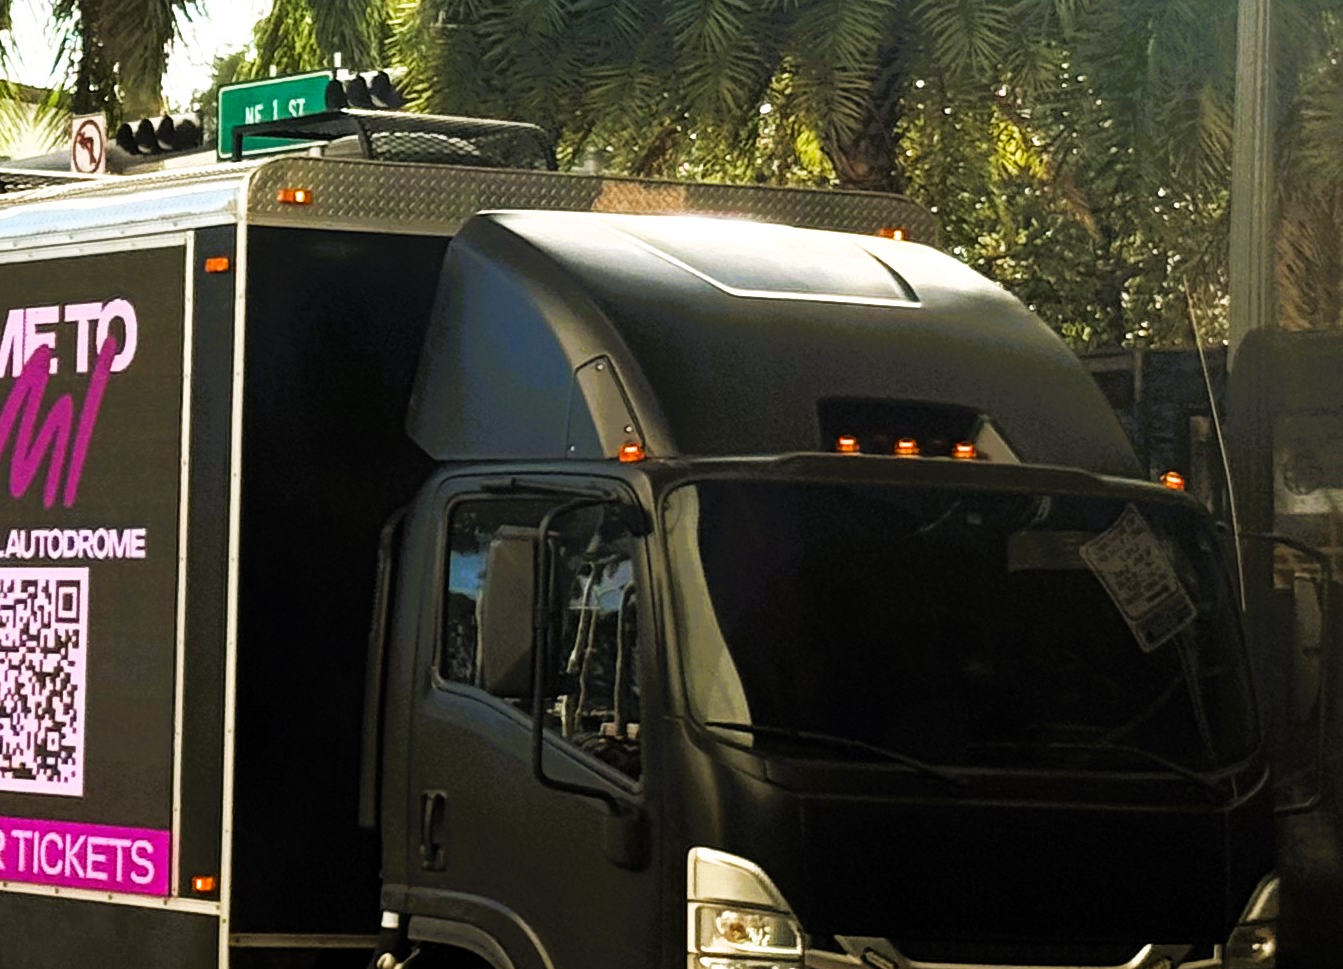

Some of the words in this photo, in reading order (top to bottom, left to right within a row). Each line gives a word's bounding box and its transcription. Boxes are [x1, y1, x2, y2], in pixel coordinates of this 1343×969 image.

[245, 103, 264, 124] NE
[272, 98, 278, 121] 1
[288, 97, 306, 118] ST
[63, 298, 138, 374] TO
[4, 527, 147, 559] AUTODROME
[11, 829, 155, 885] TICKETS
